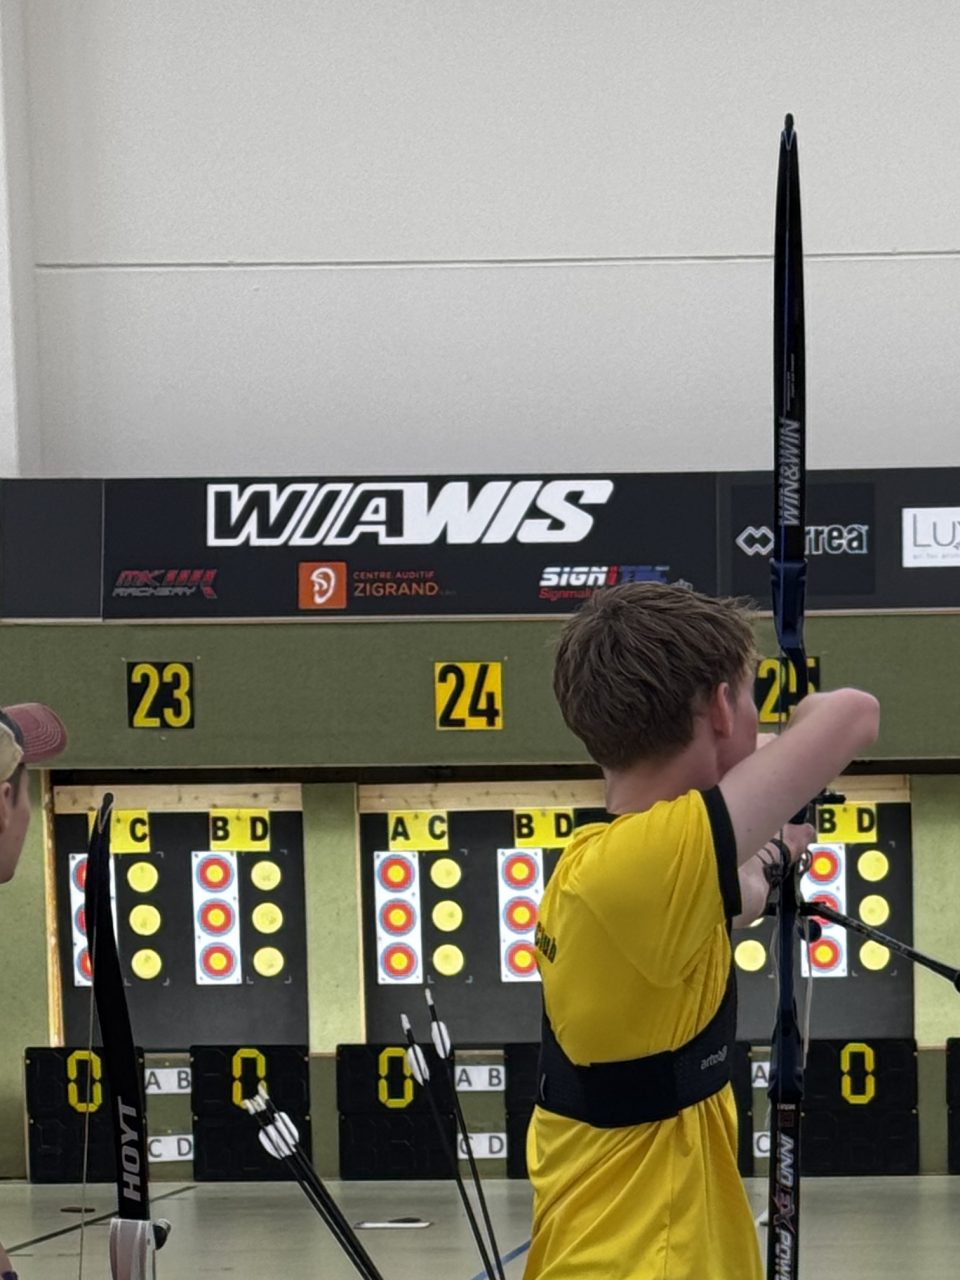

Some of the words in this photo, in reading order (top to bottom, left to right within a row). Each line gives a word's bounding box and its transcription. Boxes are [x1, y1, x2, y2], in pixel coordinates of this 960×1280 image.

[206, 480, 614, 547] WIAWIS
[353, 571, 391, 579] CENTRE
[395, 571, 434, 579] AUDITIF
[354, 582, 439, 597] ZIGRAND
[131, 663, 191, 727] 23
[438, 664, 499, 727] 24
[129, 814, 148, 844] C
[211, 815, 229, 842] B
[250, 815, 269, 842] D
[391, 815, 410, 841] A
[428, 813, 447, 840] C
[516, 813, 534, 839] B
[555, 813, 574, 838] D
[820, 812, 836, 834] B
[857, 812, 876, 832] D
[145, 1069, 161, 1090] A
[177, 1069, 191, 1089] B
[456, 1067, 472, 1088] A
[488, 1067, 502, 1088] B
[753, 1064, 768, 1082] A
[117, 1096, 142, 1202] HOYT
[148, 1139, 162, 1158] C
[177, 1138, 192, 1156] D
[489, 1136, 504, 1155] D
